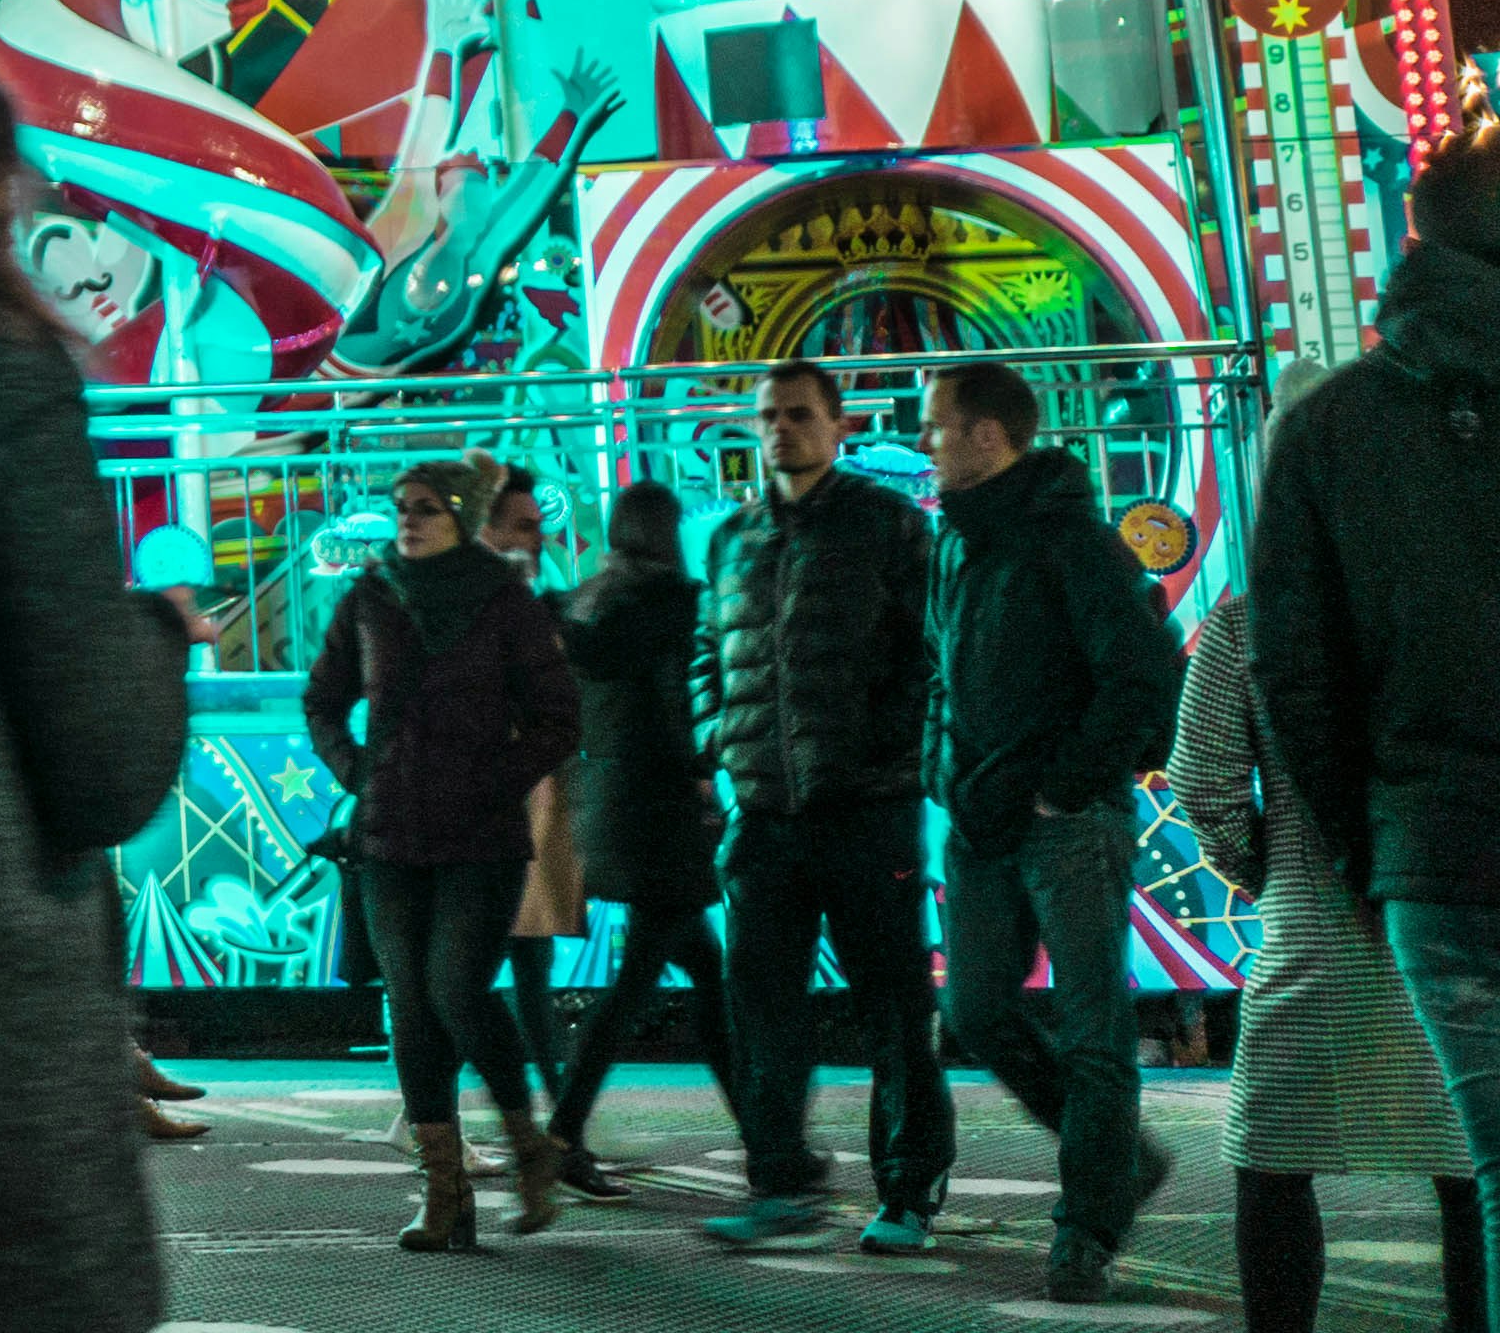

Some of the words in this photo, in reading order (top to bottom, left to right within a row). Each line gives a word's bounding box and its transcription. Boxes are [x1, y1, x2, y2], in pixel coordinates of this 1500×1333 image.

[1267, 44, 1285, 65] 9
[1273, 92, 1291, 113] 8
[1279, 144, 1295, 163] 7
[1286, 192, 1304, 213] 6
[1293, 242, 1310, 262] 5
[1299, 291, 1314, 311] 4
[1304, 340, 1322, 360] 3
